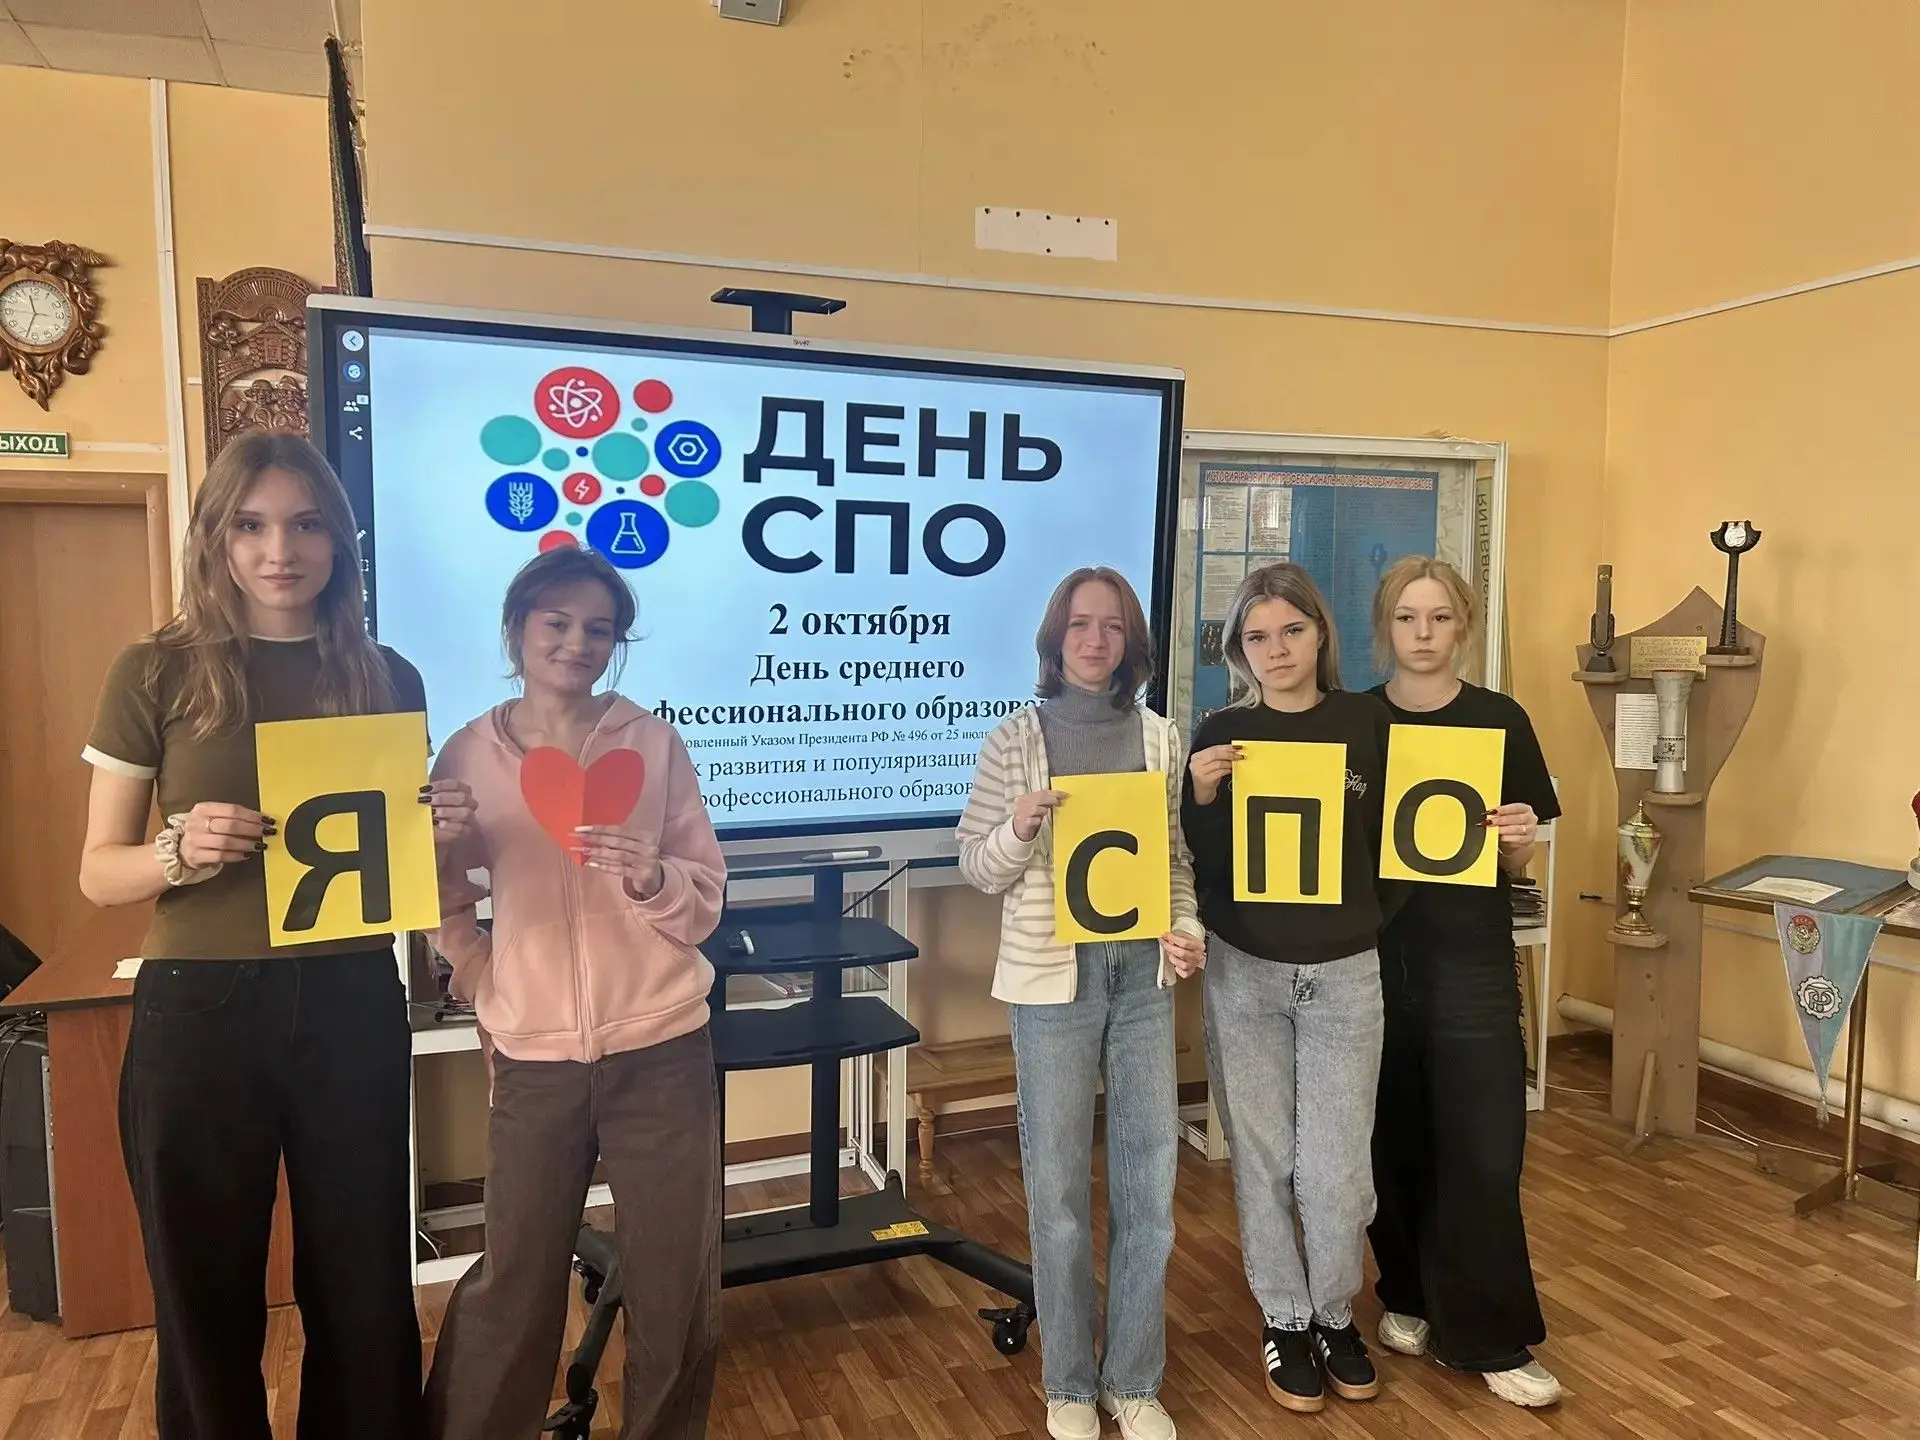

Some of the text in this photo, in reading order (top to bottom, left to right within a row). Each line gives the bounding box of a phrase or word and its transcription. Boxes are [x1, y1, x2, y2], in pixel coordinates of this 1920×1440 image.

[0, 435, 59, 452] ЫХОД
[743, 396, 1062, 487] ДЕНЬ
[742, 496, 1006, 577] СПО
[769, 604, 951, 643] 2 октября
[750, 655, 965, 686] День среднего
[652, 700, 907, 726] фессионального
[684, 736, 748, 749] овленный
[751, 733, 795, 747] Указом
[800, 732, 868, 747] Президента
[871, 730, 889, 743] РФ
[892, 731, 906, 742] №
[908, 730, 928, 742] 496
[931, 732, 944, 741] от
[946, 729, 959, 740] 25
[709, 759, 805, 781] развития
[813, 757, 826, 772] и
[1246, 795, 1321, 896] П
[1393, 778, 1487, 877] О
[282, 789, 393, 932] Я
[1066, 829, 1139, 935] С
